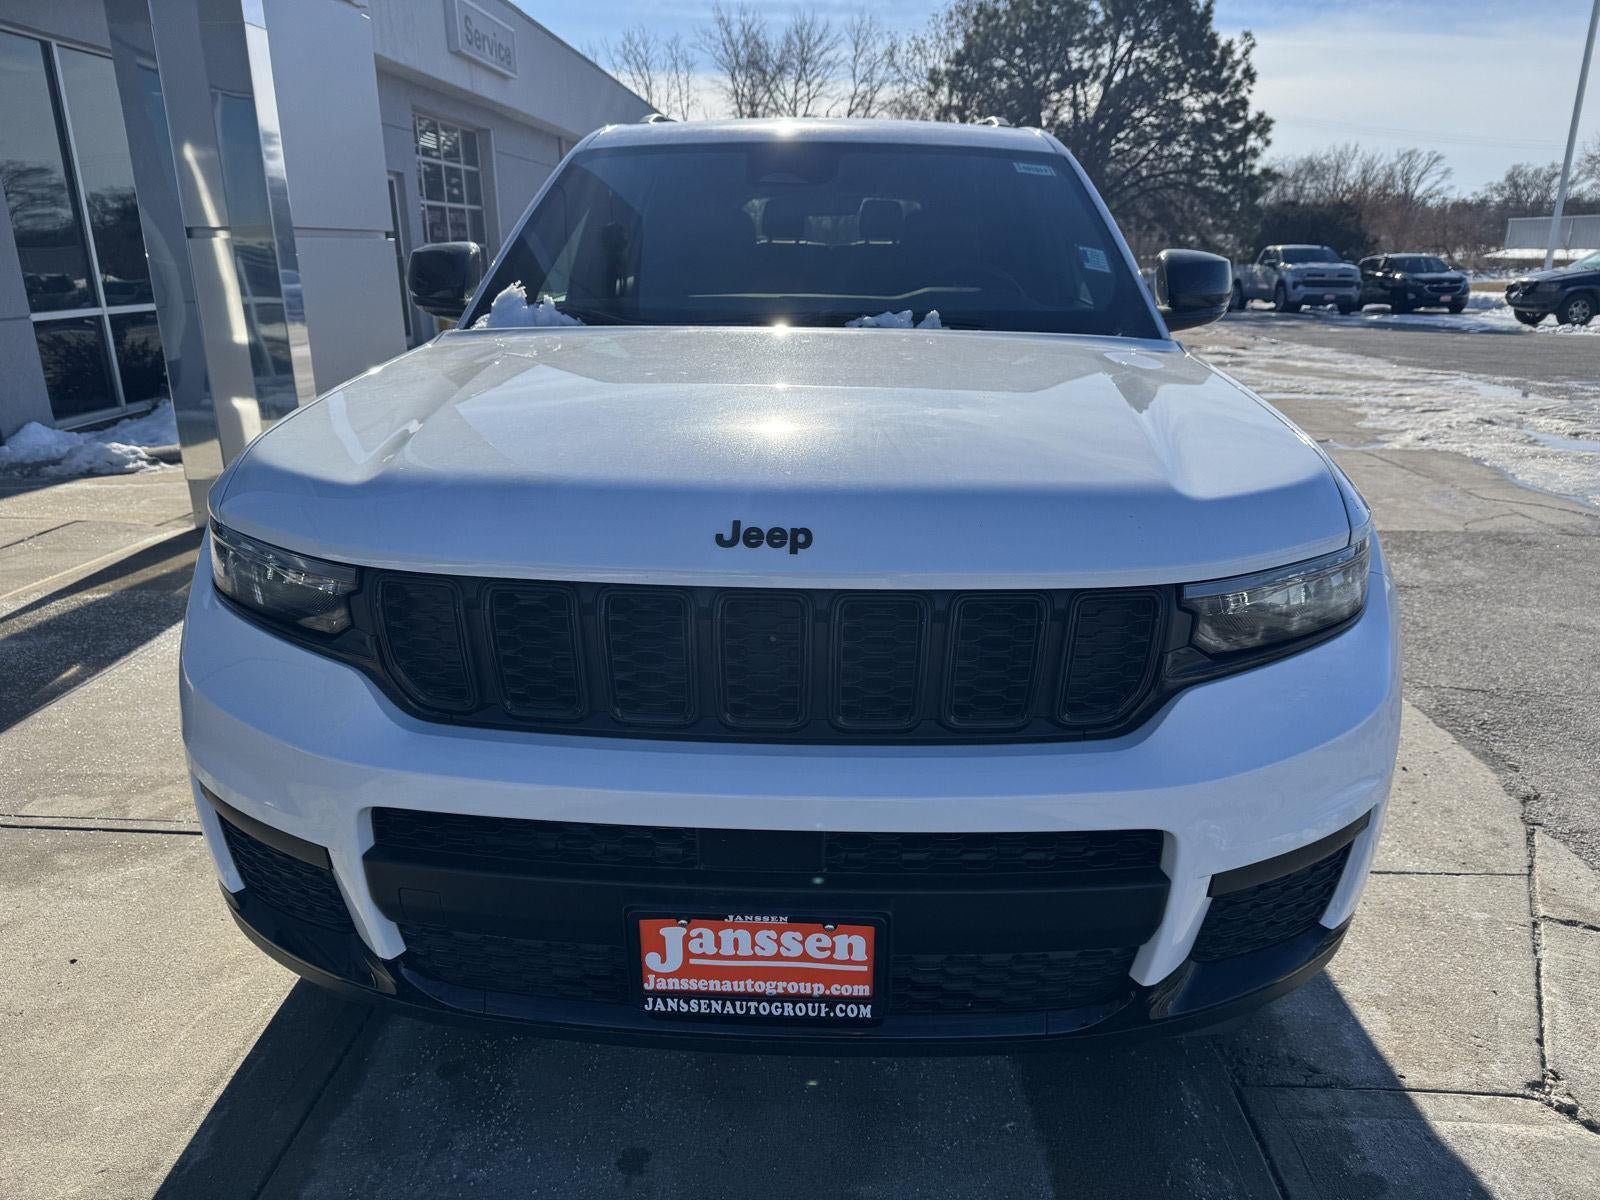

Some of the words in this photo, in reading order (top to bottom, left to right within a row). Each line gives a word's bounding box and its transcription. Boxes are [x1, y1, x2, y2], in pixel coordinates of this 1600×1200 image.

[463, 14, 512, 66] Service
[715, 519, 813, 555] Jeep
[645, 926, 868, 973] Janssen
[643, 974, 870, 997] Janssenautogroup.com
